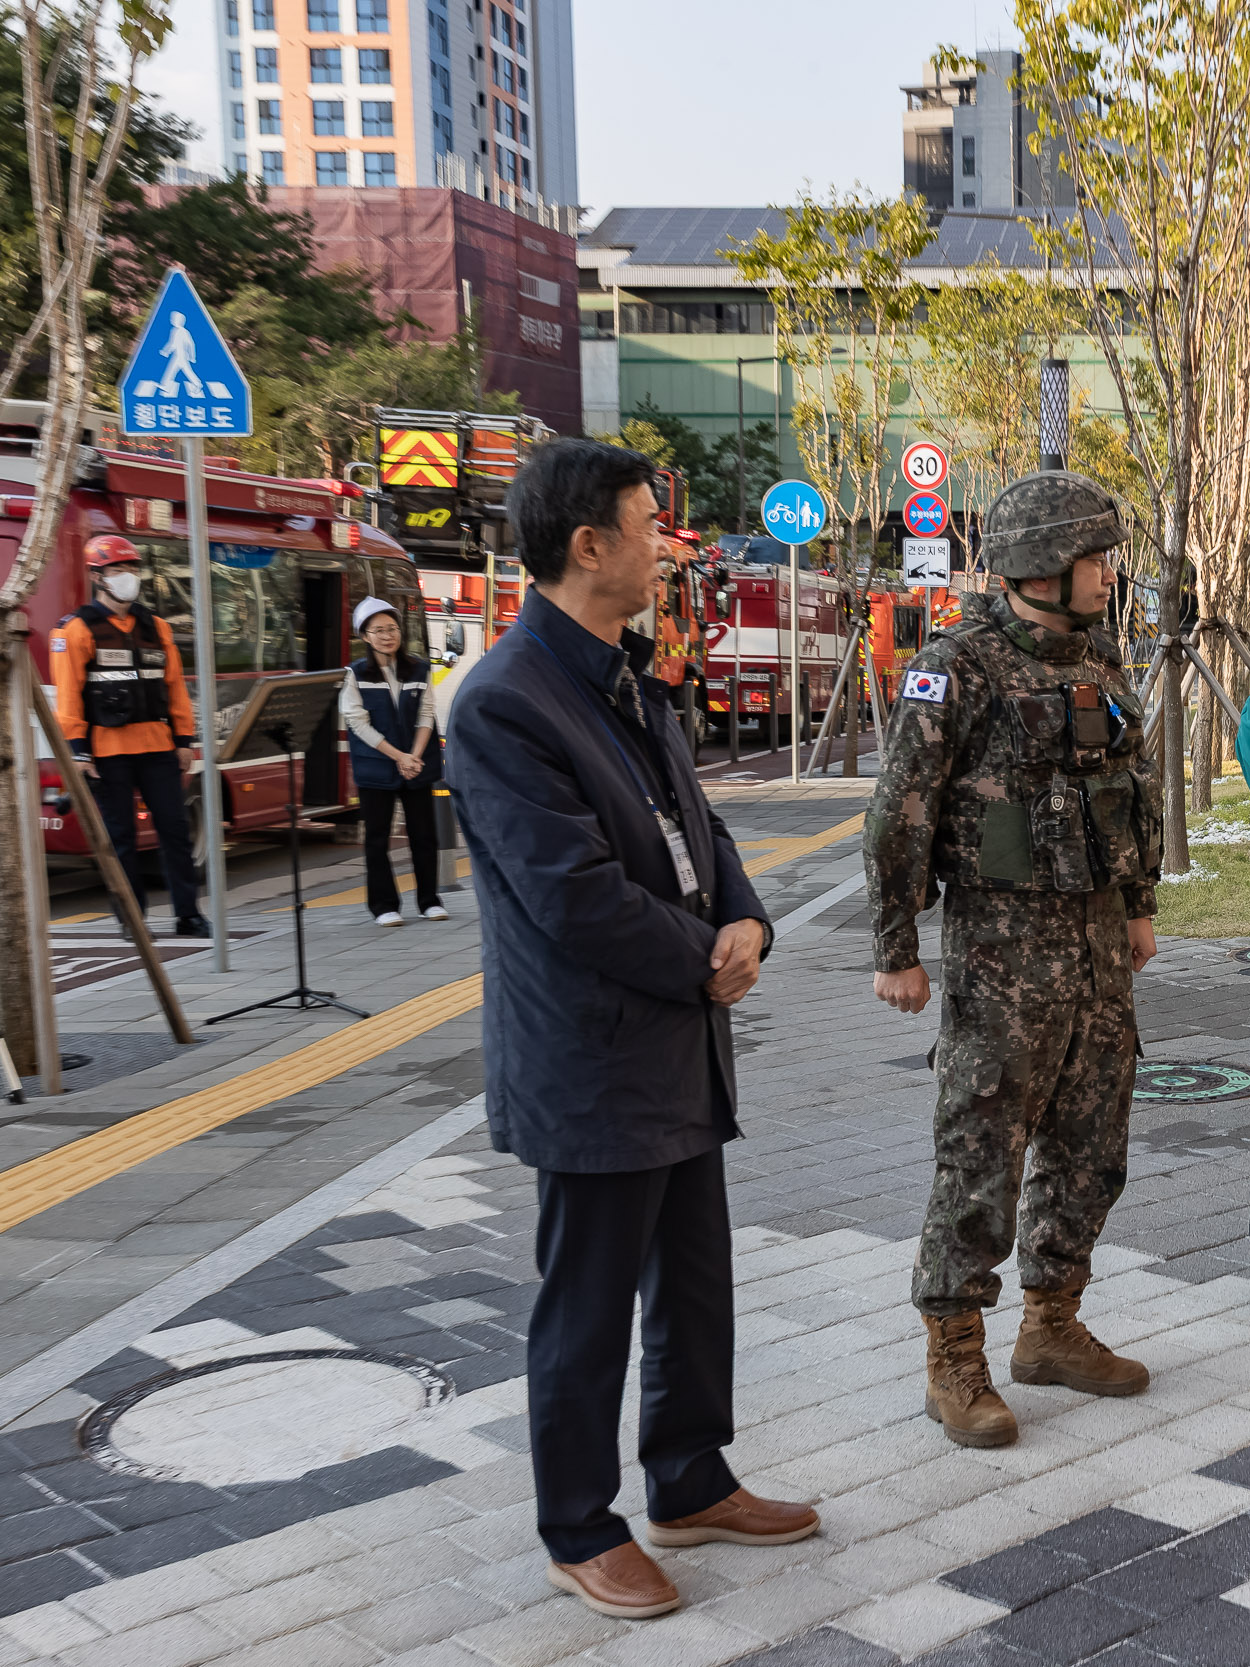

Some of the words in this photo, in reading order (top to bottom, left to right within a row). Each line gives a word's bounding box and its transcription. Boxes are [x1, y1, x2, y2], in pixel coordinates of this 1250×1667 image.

[132, 402, 235, 429] 횡단보도
[913, 456, 938, 476] 30
[907, 545, 946, 556] 견인지역
